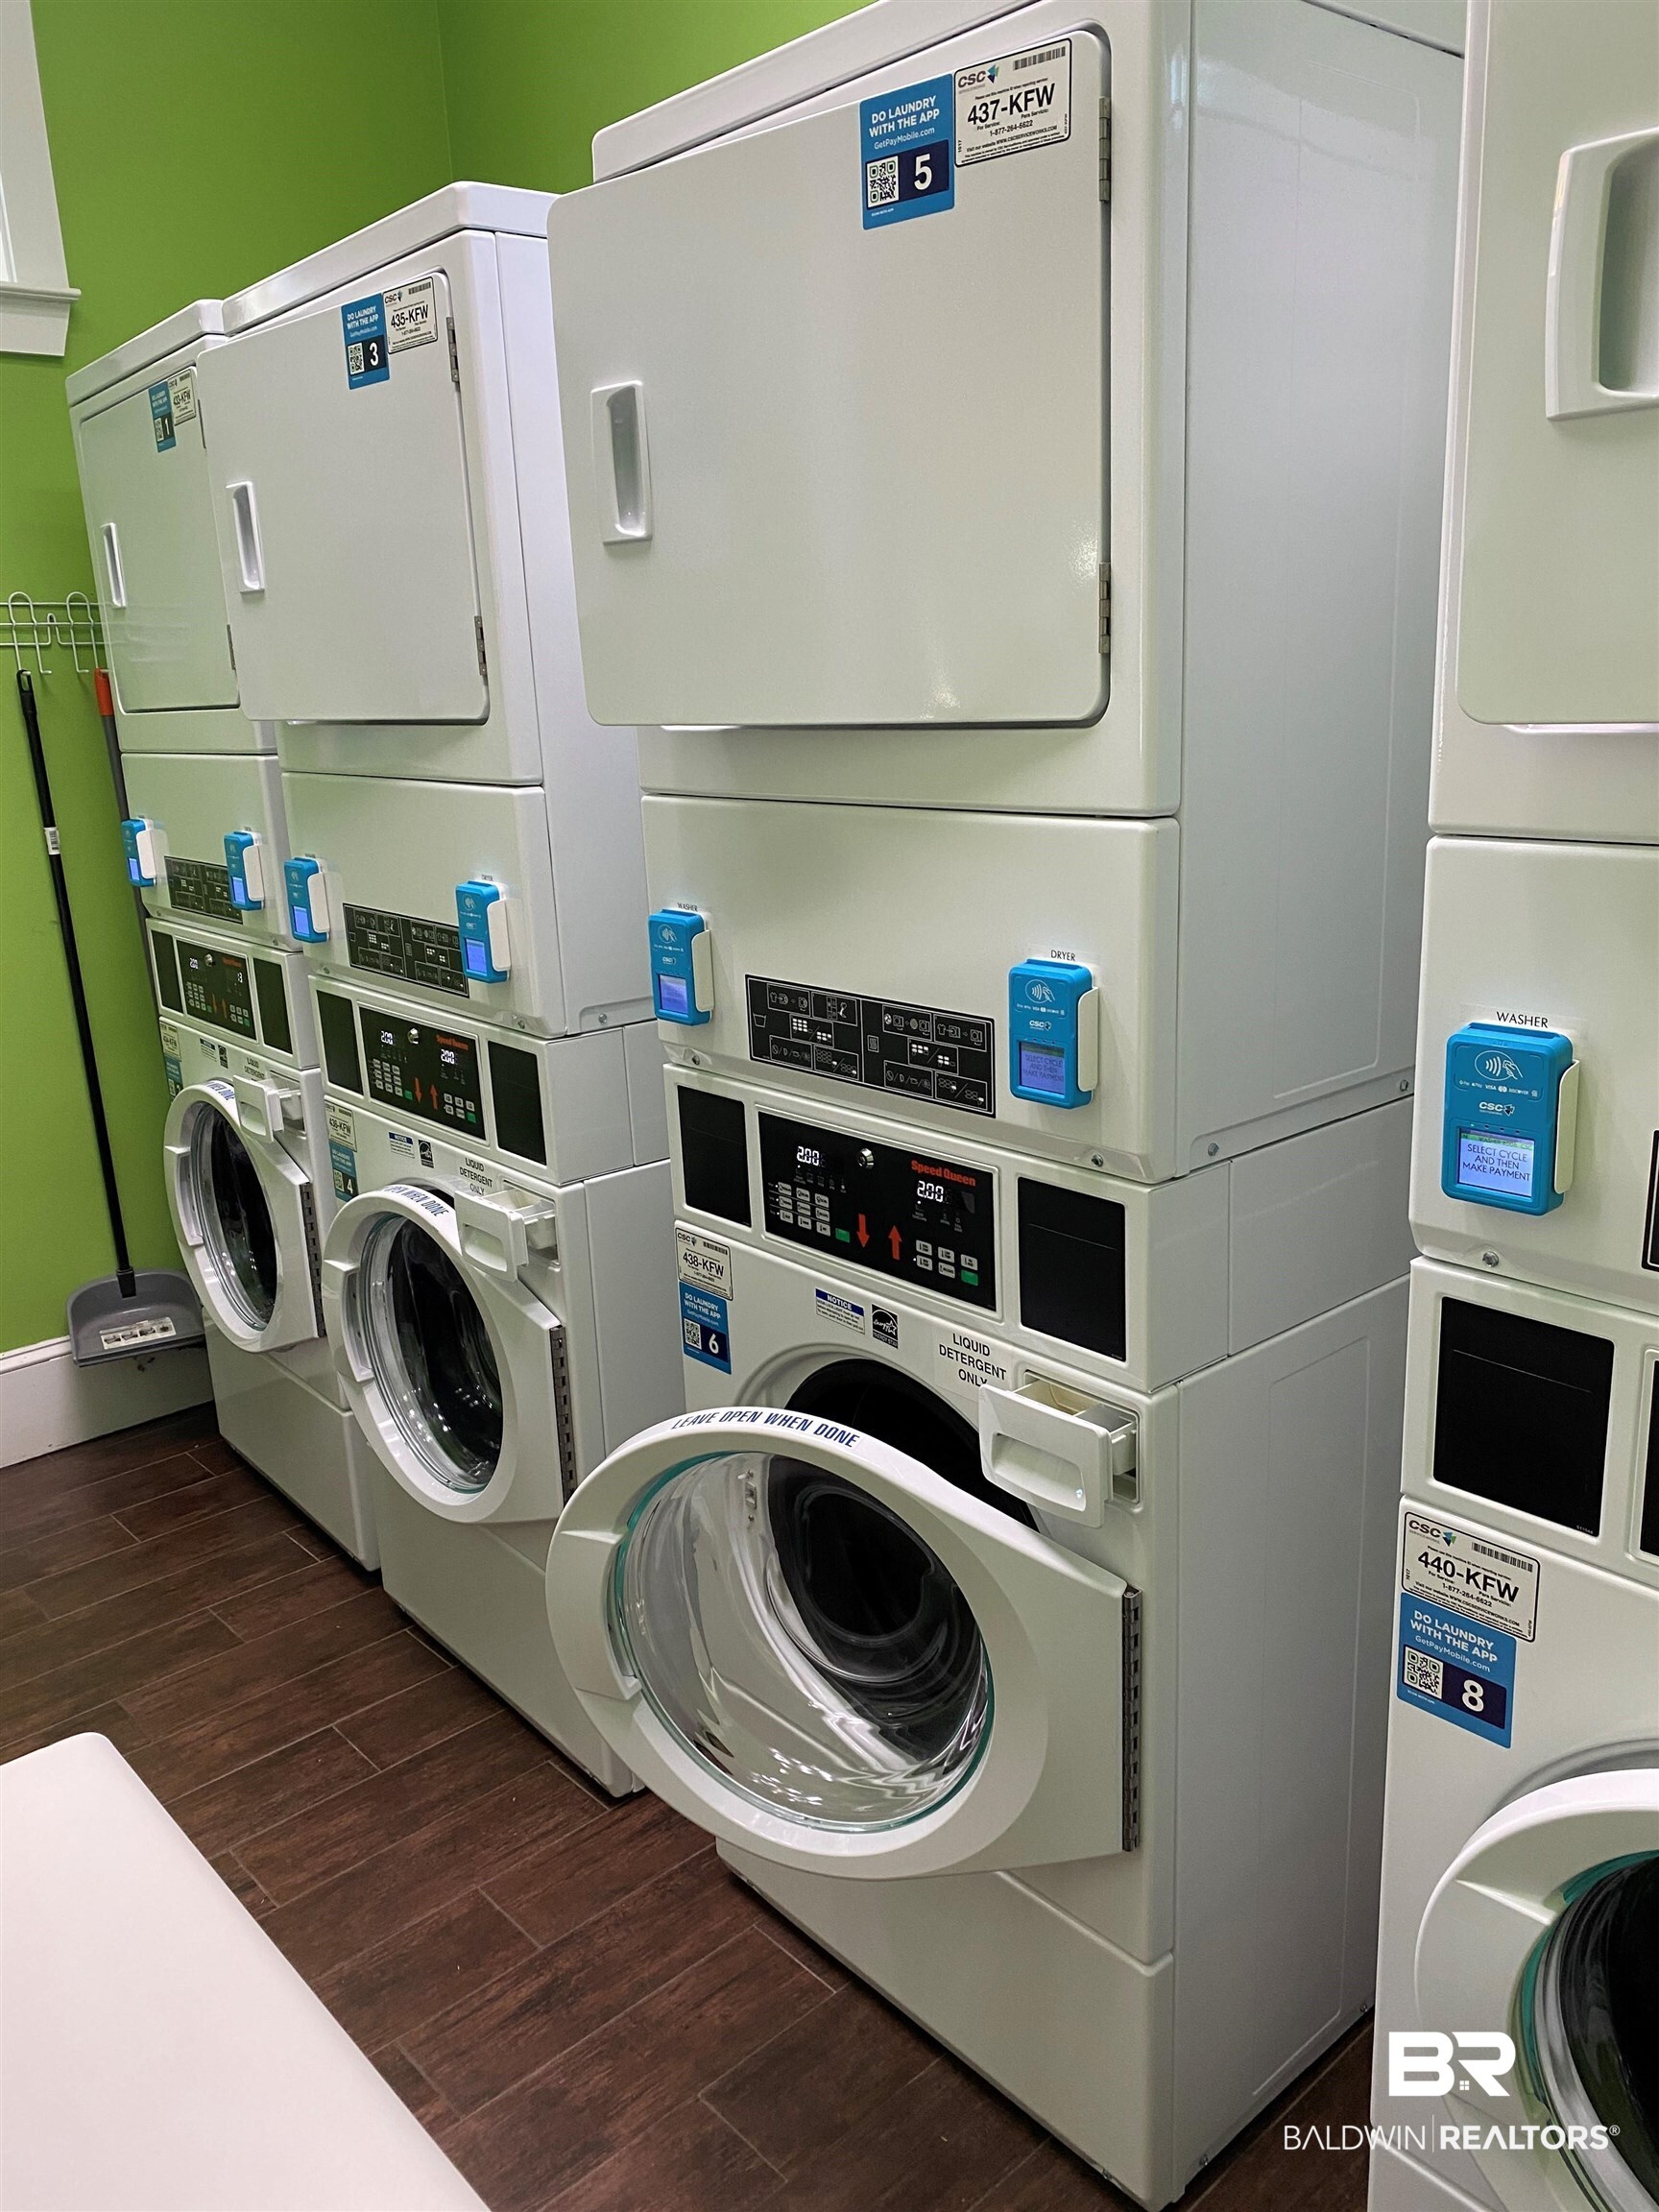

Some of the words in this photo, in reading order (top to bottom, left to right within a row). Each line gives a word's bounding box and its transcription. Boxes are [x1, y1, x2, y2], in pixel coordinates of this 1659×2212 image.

[958, 71, 986, 87] CSC
[872, 111, 886, 125] DO
[889, 96, 936, 119] LAUNDRY
[968, 83, 1055, 125] 437-KFW
[869, 121, 895, 137] WITH
[898, 115, 917, 129] THE
[920, 108, 940, 123] APP
[874, 127, 935, 150] GetPayMobile.com
[914, 154, 932, 190] 5
[384, 294, 397, 303] CSC
[355, 305, 376, 319] LAUNDRY
[360, 317, 369, 326] THE
[370, 314, 378, 323] APP
[390, 304, 428, 328] 435-KFW
[369, 342, 378, 366] 3
[165, 417, 170, 436] 1
[1050, 950, 1075, 962] DRYER
[1496, 1011, 1549, 1029] WASHER
[1479, 1101, 1503, 1112] CSC
[1467, 1143, 1496, 1156] SELECT
[1499, 1149, 1527, 1162] CYCLE
[1475, 1155, 1495, 1166] AND
[1497, 1158, 1519, 1169] THEN
[465, 1157, 485, 1171] LIQUID
[910, 1160, 943, 1177] Speed
[943, 1167, 975, 1187] Queen
[1462, 1162, 1487, 1173] MAKE
[1490, 1166, 1530, 1181] PAYMENT
[347, 1178, 353, 1194] 4
[459, 1167, 493, 1188] DETERGENT
[469, 1183, 485, 1196] ONLY
[678, 1232, 690, 1242] CSC
[683, 1252, 724, 1277] 438-KFW
[685, 1292, 692, 1301] DO
[693, 1296, 718, 1311] LAUNDRY
[685, 1299, 698, 1310] WITH
[699, 1305, 709, 1314] THE
[710, 1310, 721, 1319] APP
[828, 1294, 853, 1310] NOTICE
[709, 1334, 719, 1354] 6
[952, 1333, 991, 1357] LIQUID
[939, 1344, 1006, 1381] DETERGENT
[671, 1411, 720, 1430] LEAVE
[718, 1410, 763, 1423] OPEN
[763, 1411, 813, 1432] WHEN
[813, 1423, 860, 1448] DONE
[1409, 1520, 1441, 1537] CSC
[1418, 1551, 1519, 1602] 440-KFW
[1442, 1582, 1492, 1607] 1-877-264-6622
[1414, 1610, 1432, 1624] DO
[1435, 1619, 1494, 1650] LAUNDRY
[1409, 1619, 1442, 1641] WITH
[1445, 1634, 1469, 1651] THE
[1471, 1647, 1498, 1663] APP
[1415, 1635, 1490, 1672] GetPayMobile.com
[1461, 1678, 1484, 1712] 8
